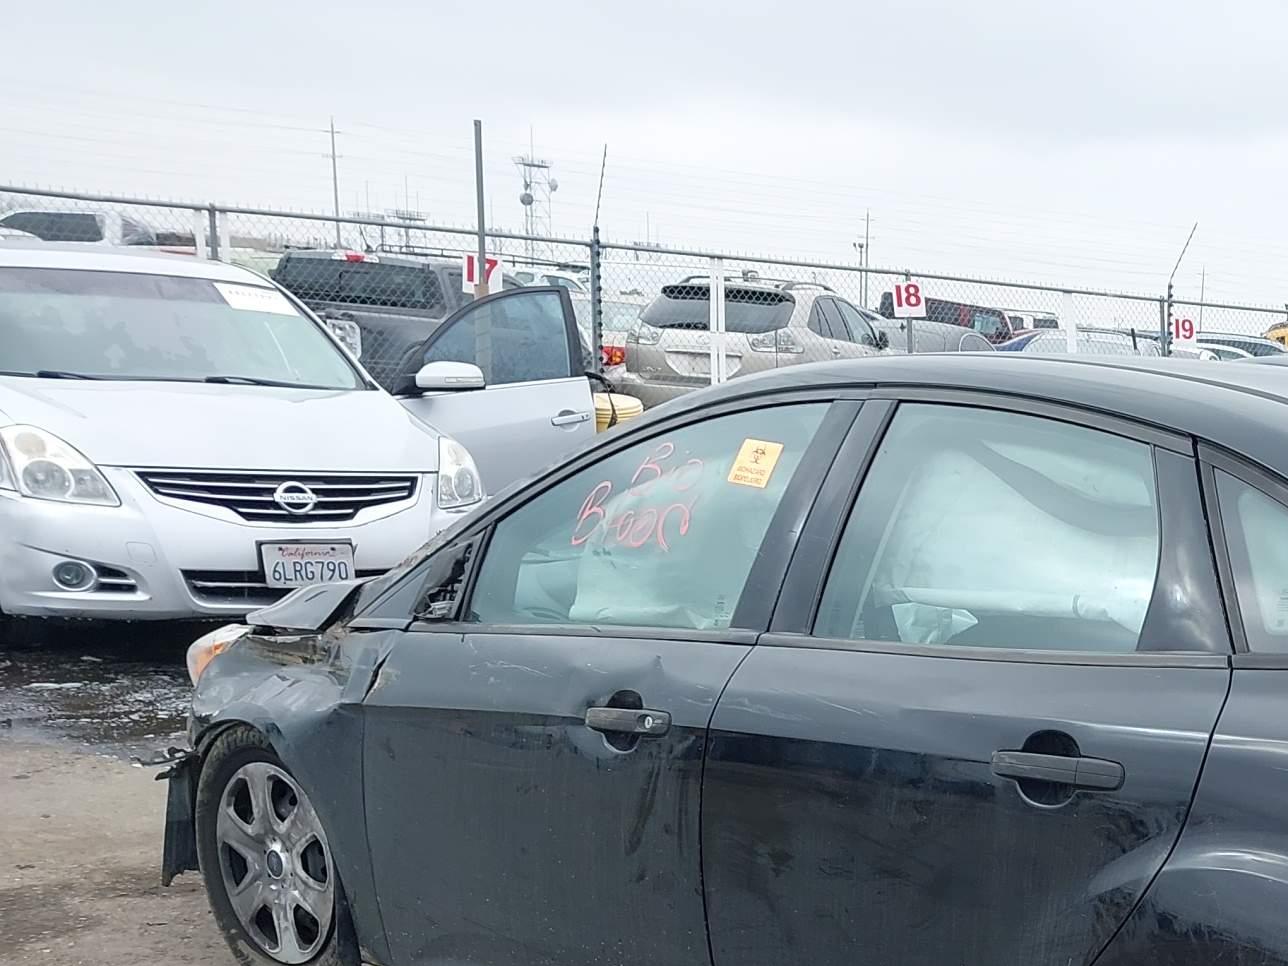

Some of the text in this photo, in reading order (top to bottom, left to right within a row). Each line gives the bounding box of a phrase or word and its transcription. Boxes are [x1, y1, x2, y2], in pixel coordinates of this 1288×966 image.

[467, 255, 498, 284] 17
[895, 284, 922, 307] 18
[1175, 318, 1194, 339] 19
[280, 546, 331, 560] California
[272, 561, 349, 582] 6LRG790
